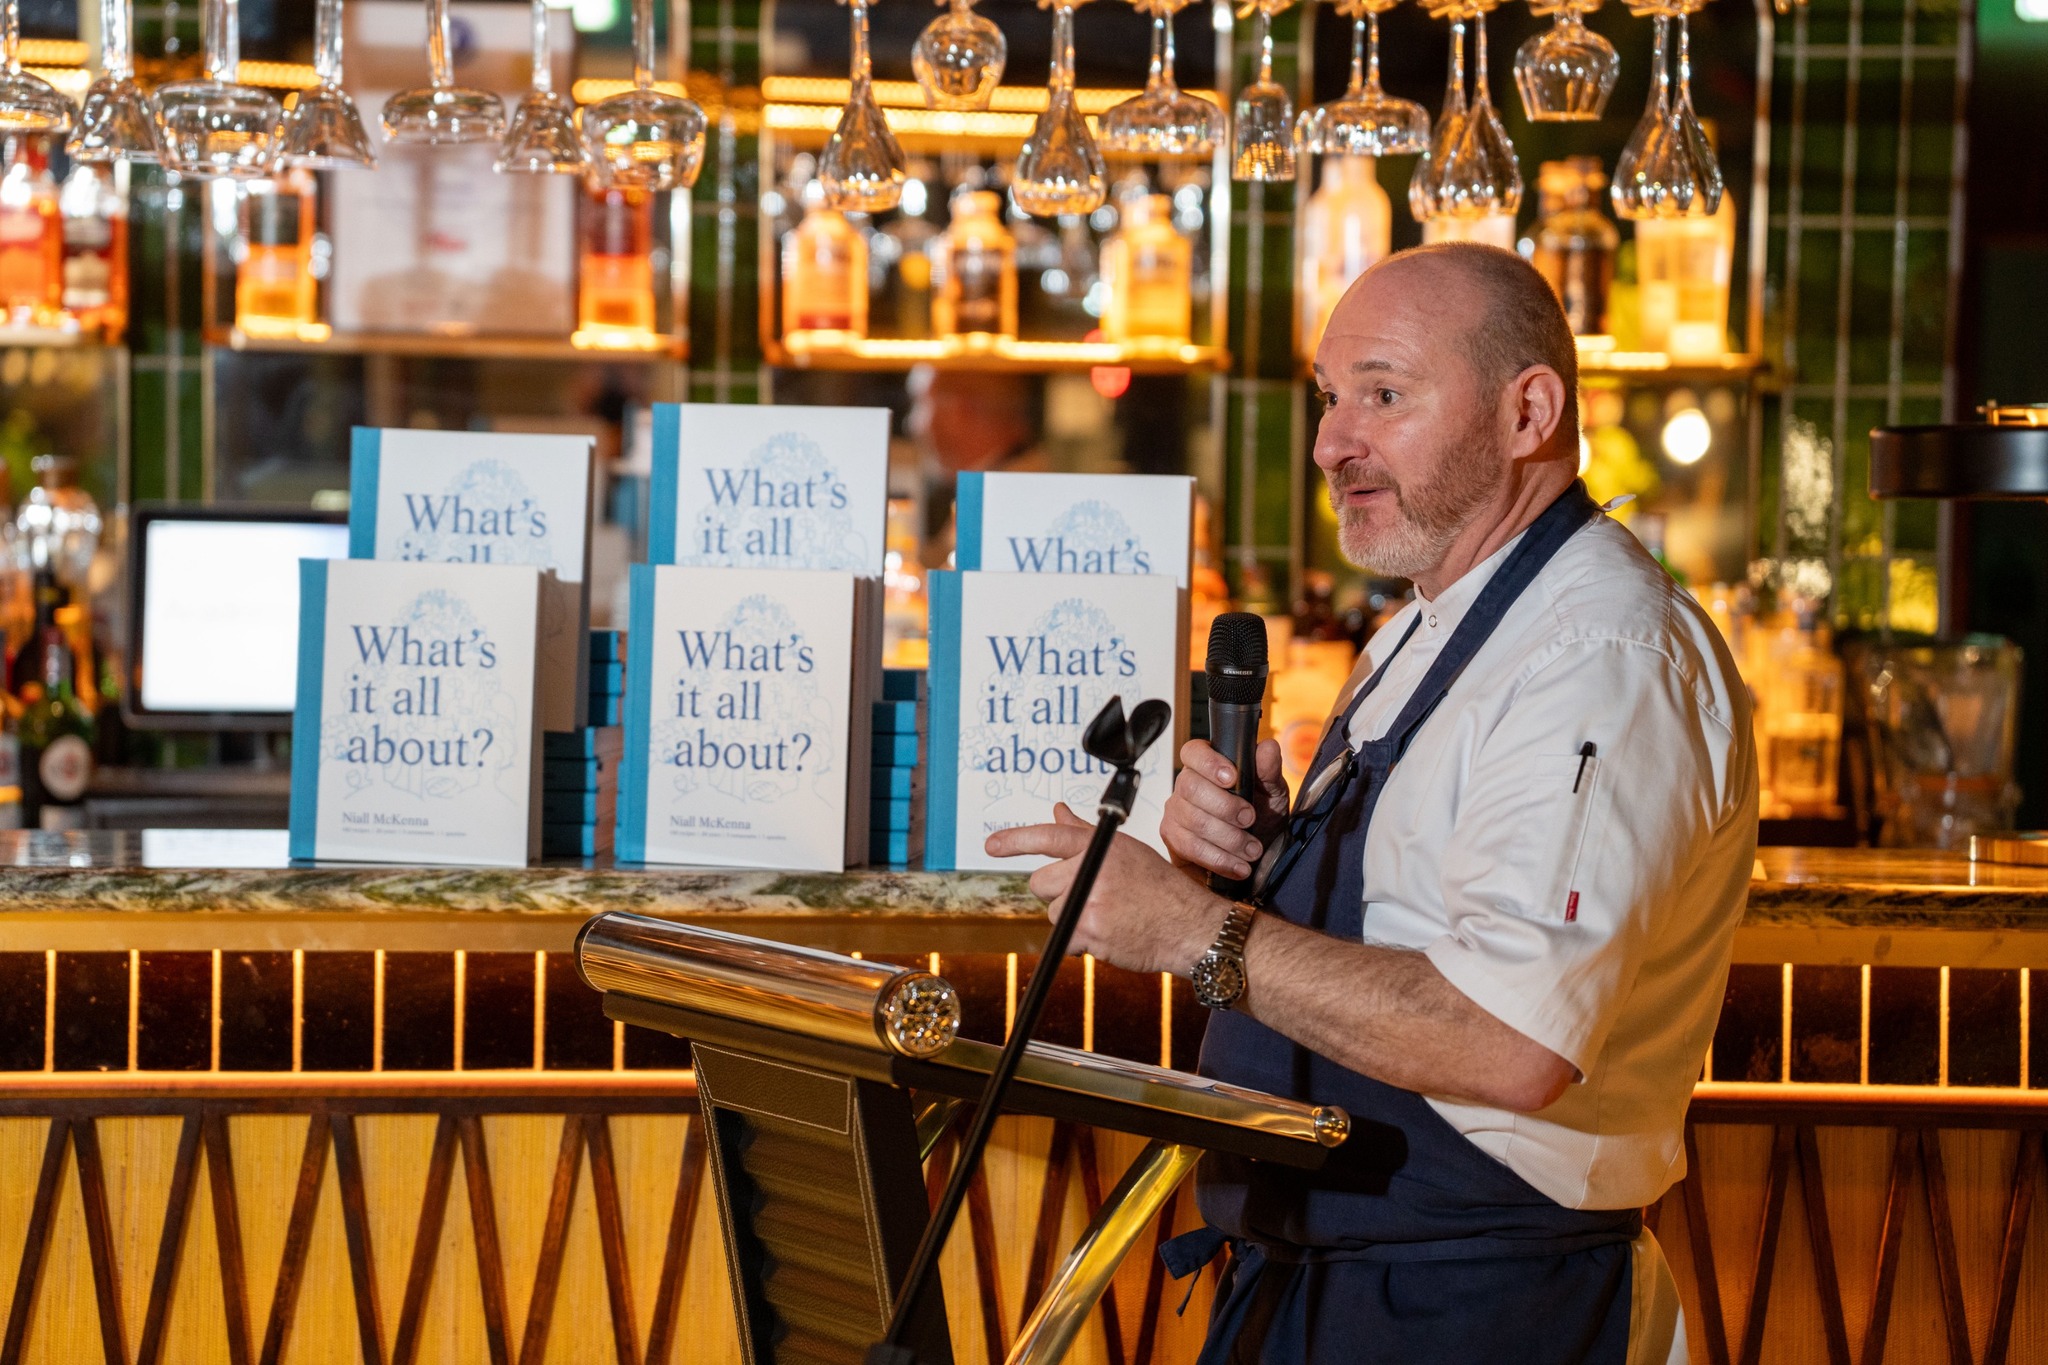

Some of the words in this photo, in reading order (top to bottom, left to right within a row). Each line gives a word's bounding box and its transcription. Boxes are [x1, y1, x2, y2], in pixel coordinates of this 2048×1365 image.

[703, 466, 848, 509] What's
[403, 494, 547, 538] What's
[702, 516, 728, 554] it
[745, 517, 792, 556] all
[446, 544, 492, 563] ll
[1006, 535, 1151, 575] What's
[350, 624, 497, 669] What's
[676, 629, 815, 674] What's
[985, 634, 1137, 677] What's
[348, 674, 377, 714] it
[392, 675, 441, 717] all
[675, 678, 702, 718] it
[716, 680, 762, 721] all
[986, 685, 1015, 724] it
[1031, 684, 1081, 725] all
[346, 723, 495, 768] about?
[674, 727, 813, 772] about?
[342, 812, 370, 825] Niall
[374, 813, 430, 827] McKenna
[669, 815, 696, 828] Niall
[698, 816, 752, 830] McKenna
